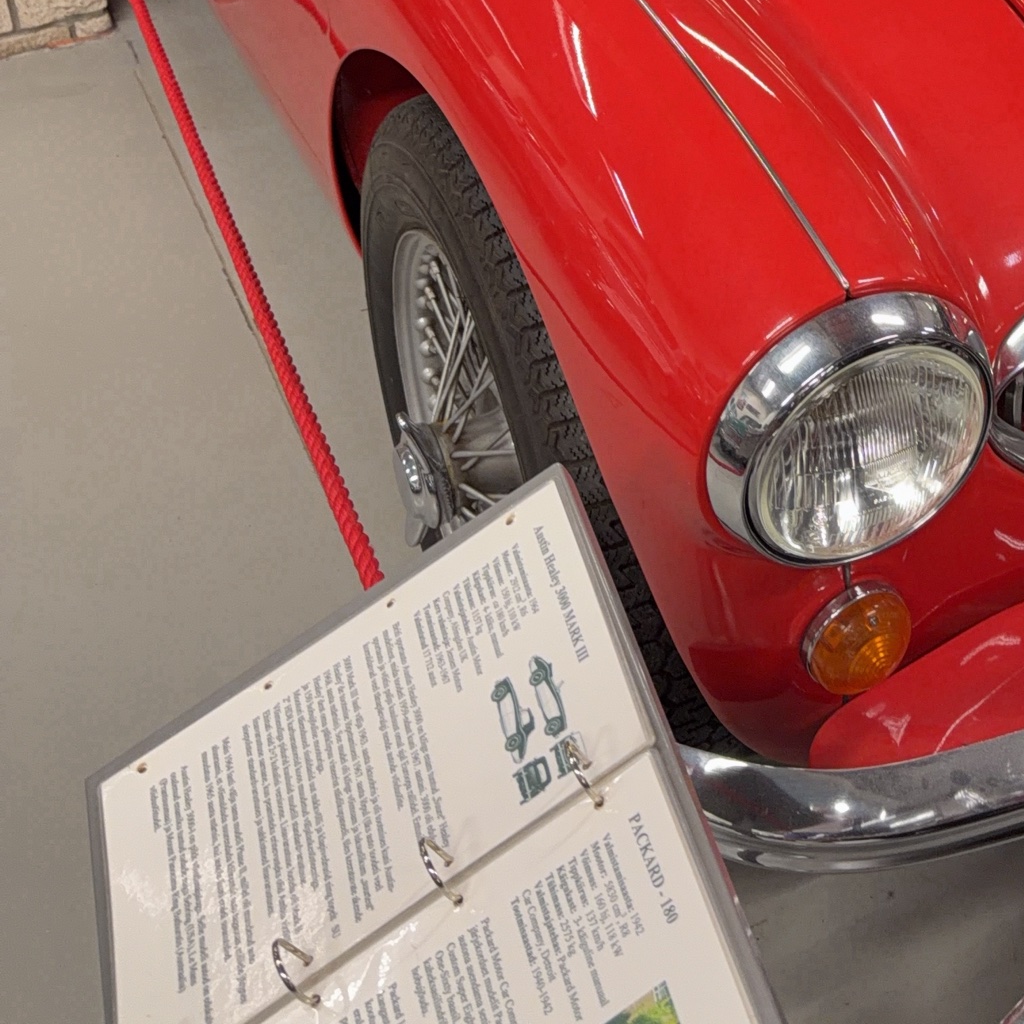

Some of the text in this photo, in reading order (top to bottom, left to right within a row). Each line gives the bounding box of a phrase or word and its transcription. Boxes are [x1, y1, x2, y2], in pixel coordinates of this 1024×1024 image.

[533, 522, 589, 663] Austin Healey 3000 MARK III
[628, 811, 665, 890] PACKARD
[659, 896, 679, 926] 180
